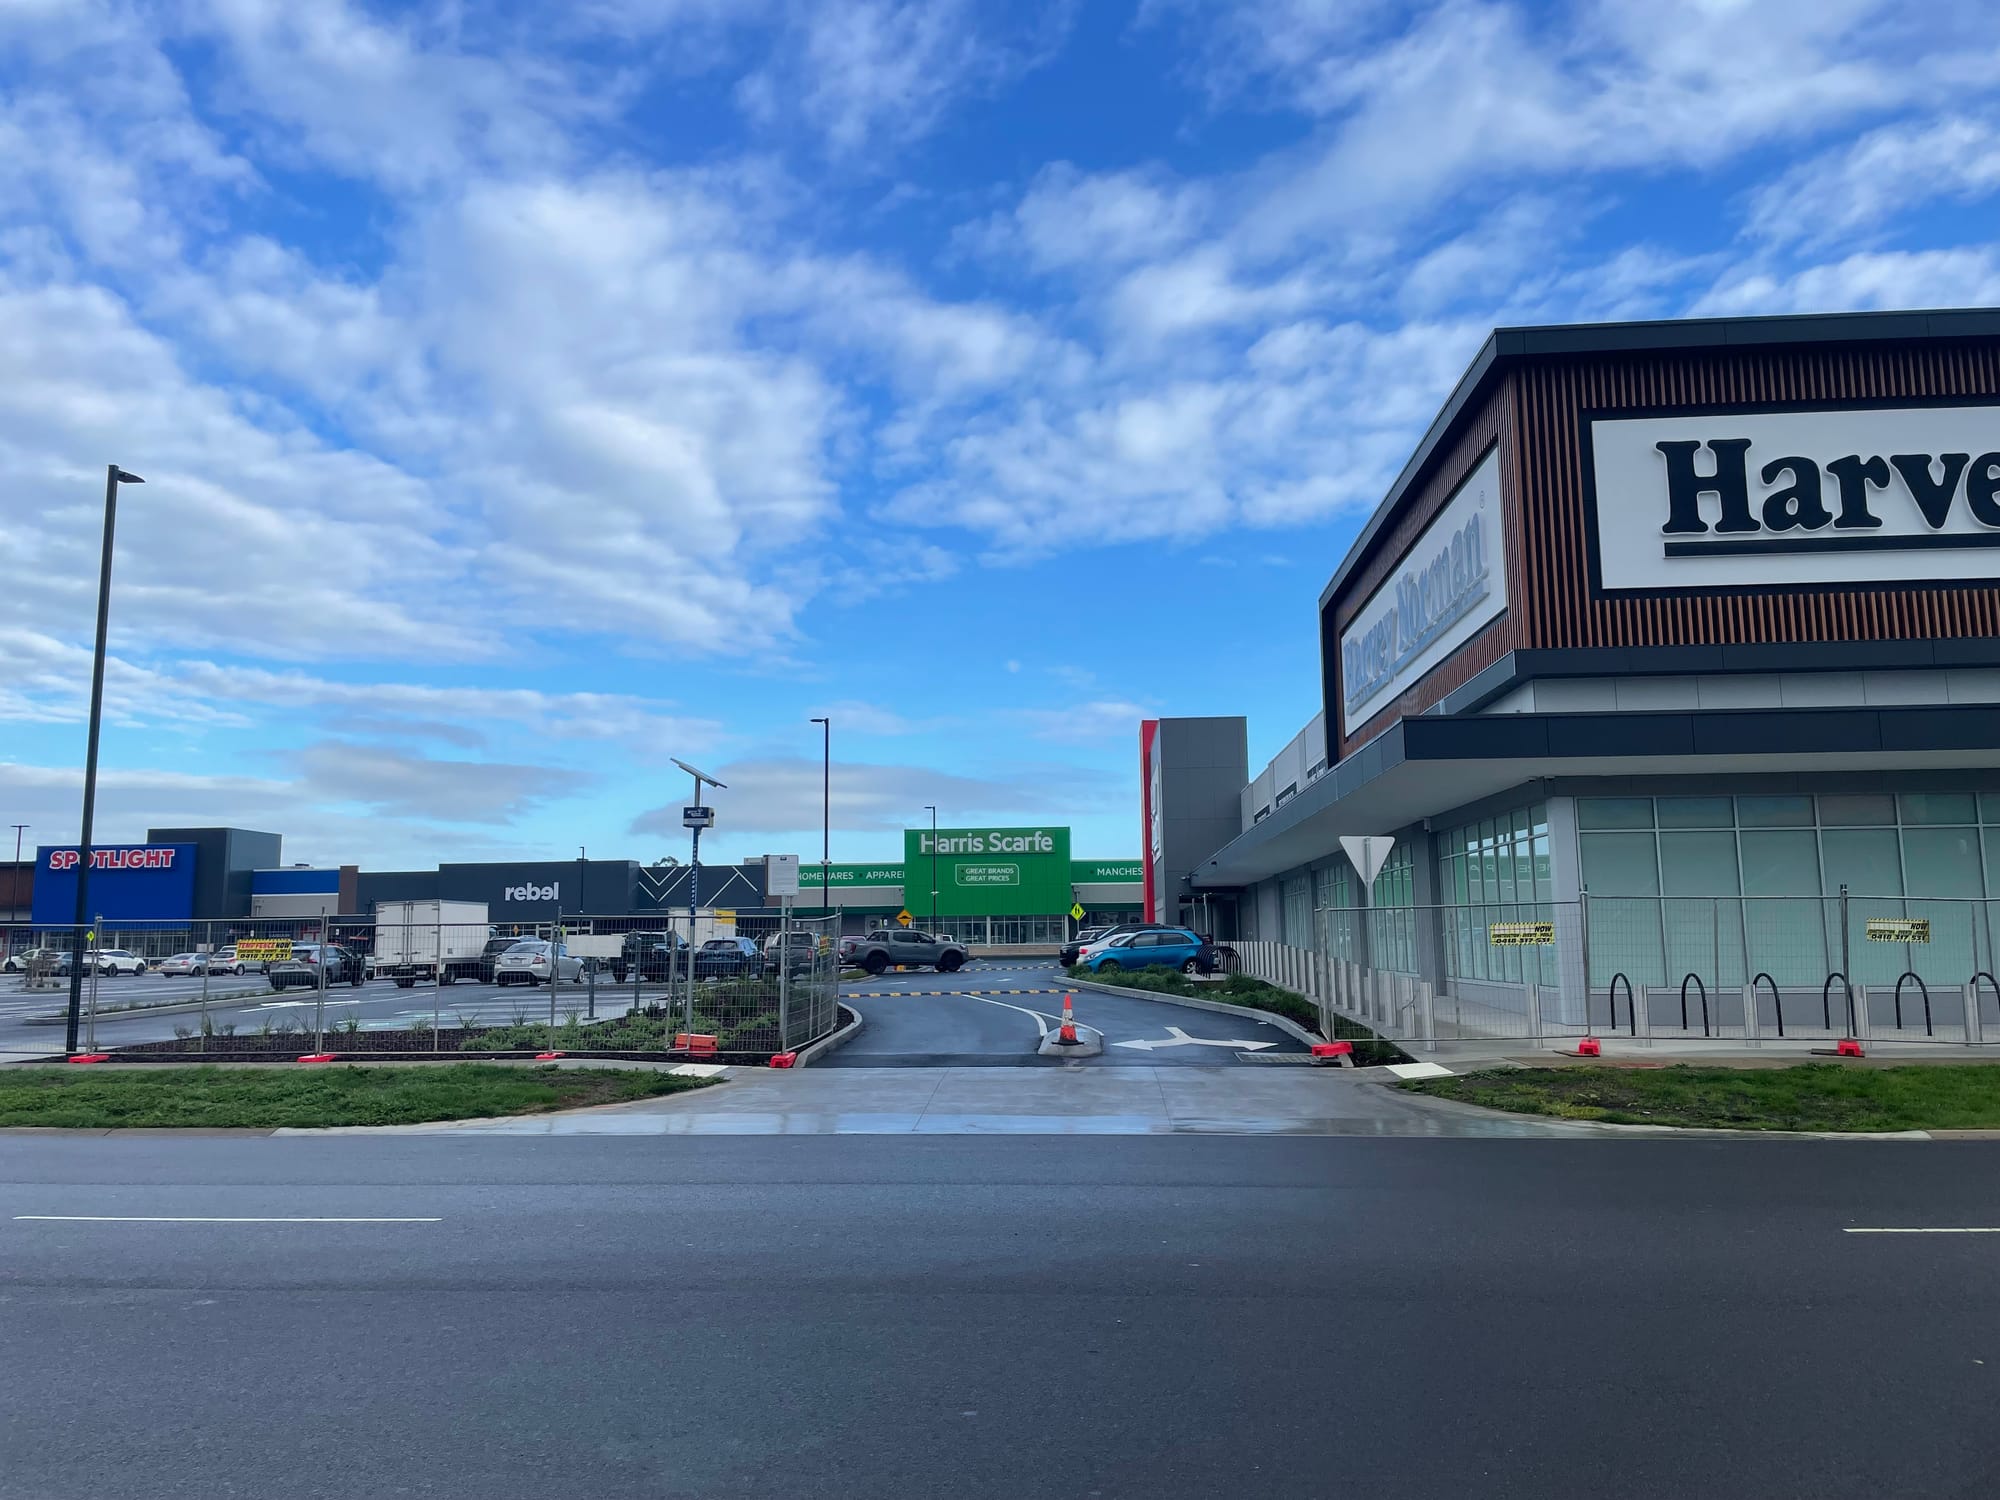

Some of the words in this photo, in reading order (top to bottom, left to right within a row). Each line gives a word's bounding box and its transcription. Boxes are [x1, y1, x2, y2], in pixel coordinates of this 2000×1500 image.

[1343, 607, 1396, 704] Harvey
[1395, 511, 1490, 655] Norman
[920, 832, 984, 853] Harris
[988, 831, 1053, 852] Scarfe
[1097, 867, 1143, 876] MANCHES
[505, 882, 559, 901] rebel
